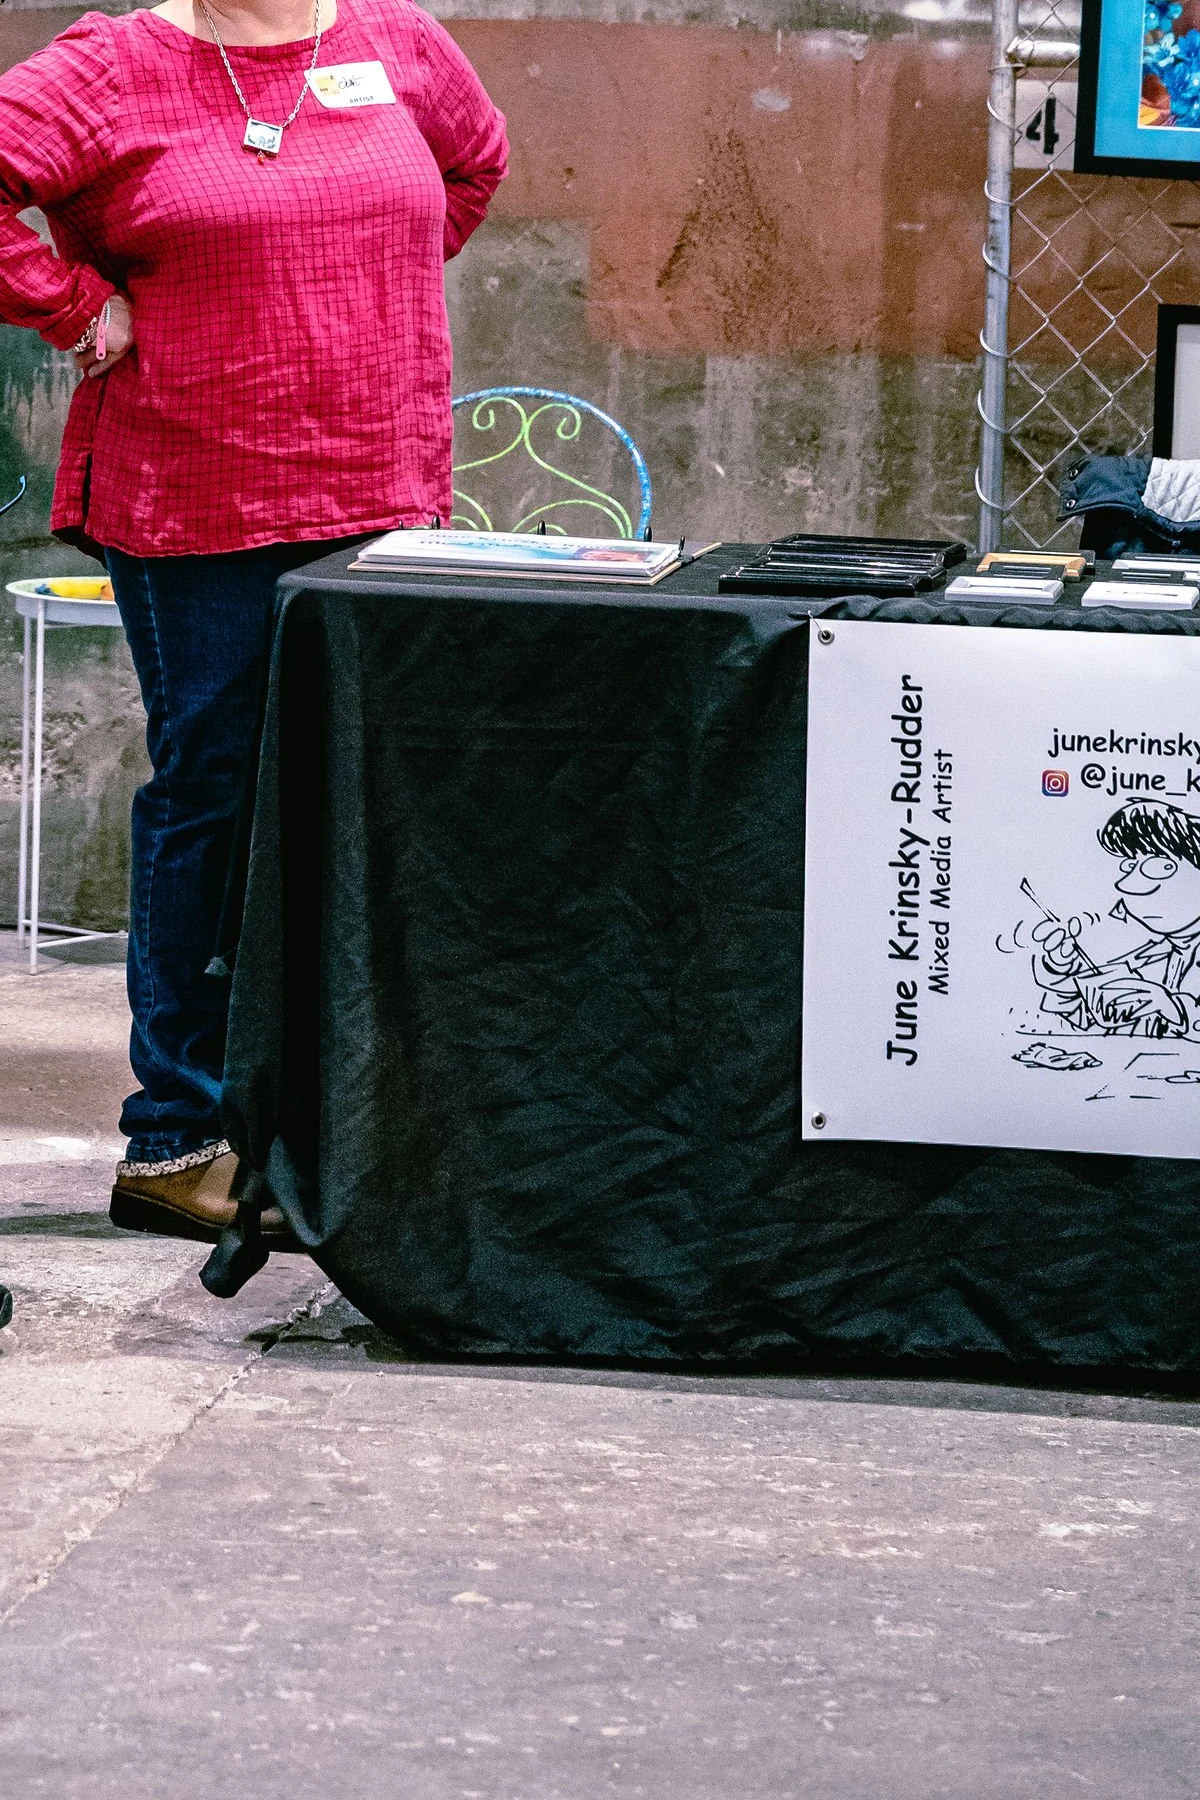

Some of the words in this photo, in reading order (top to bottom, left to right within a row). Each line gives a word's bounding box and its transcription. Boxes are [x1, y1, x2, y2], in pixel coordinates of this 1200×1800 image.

[888, 674, 931, 961] Krinsky-Rudder
[932, 749, 953, 824] Artist
[929, 836, 951, 909] Media
[928, 920, 950, 995] Mixed
[887, 980, 918, 1066] June
